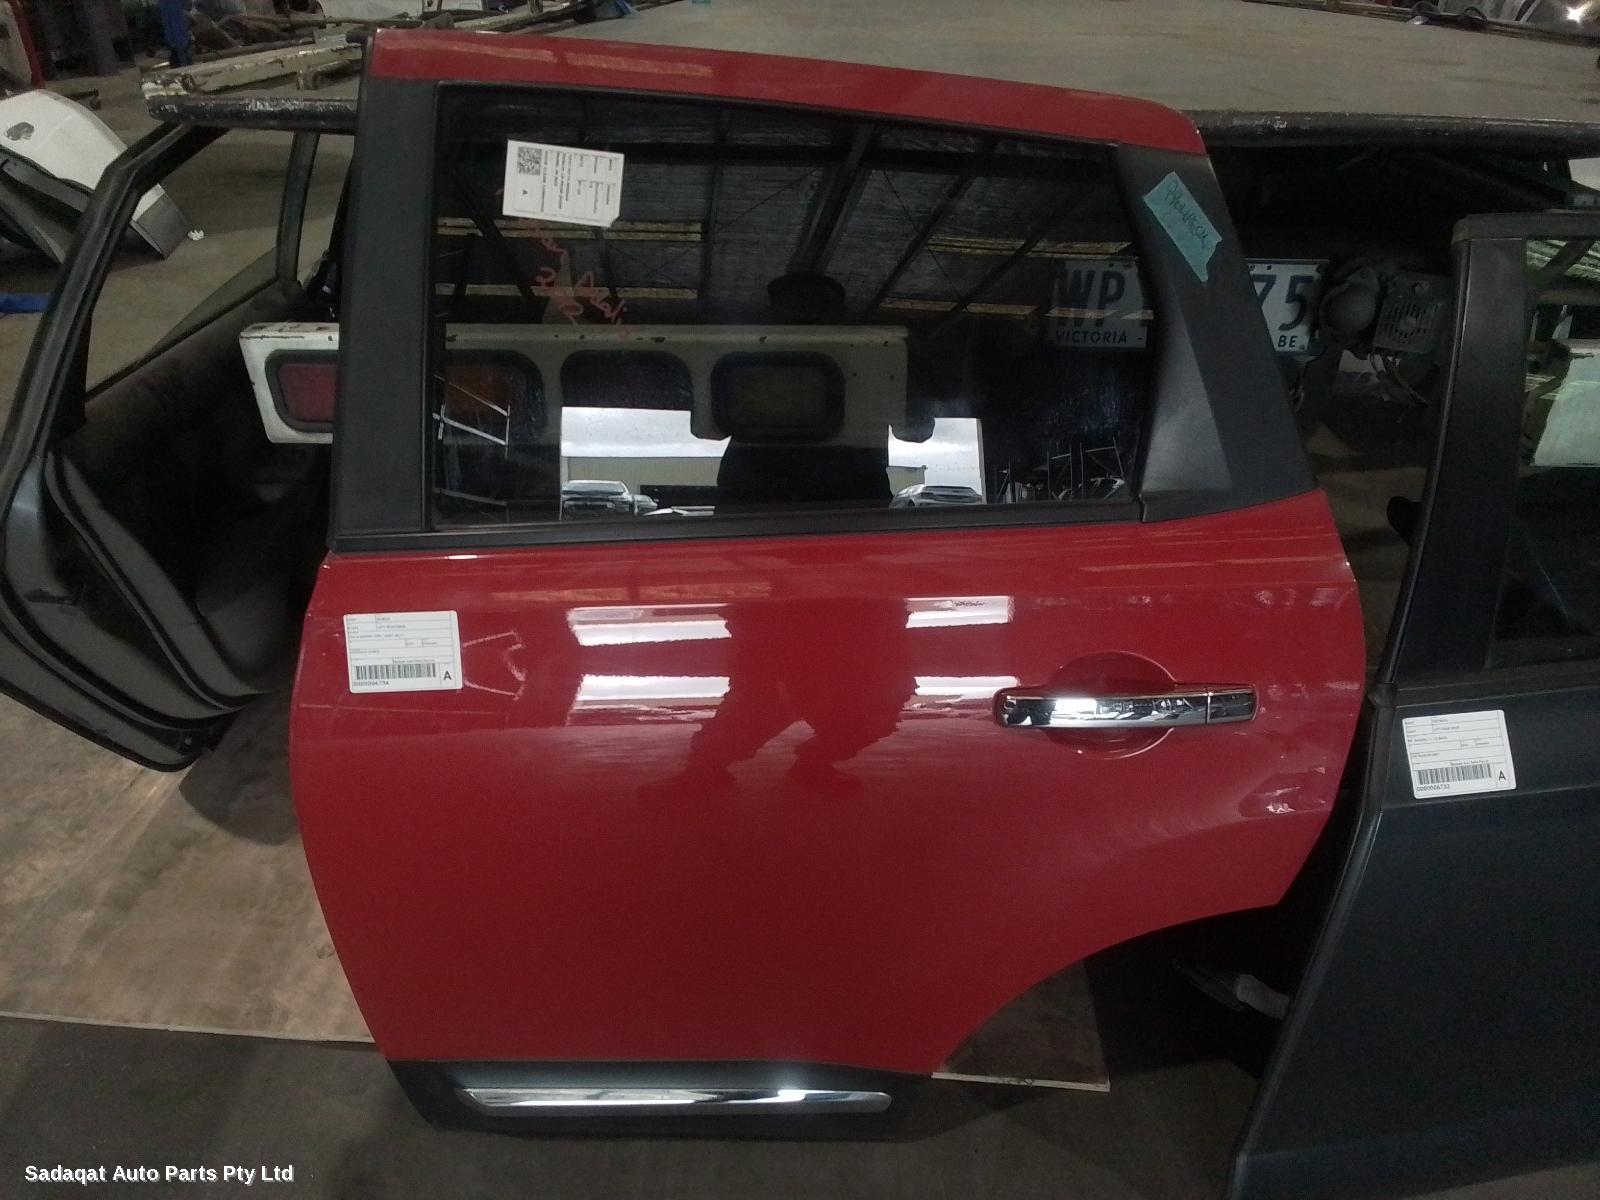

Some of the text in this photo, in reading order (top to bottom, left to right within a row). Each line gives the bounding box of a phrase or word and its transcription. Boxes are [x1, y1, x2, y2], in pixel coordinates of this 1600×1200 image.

[1055, 270, 1313, 330] WP 75
[1055, 330, 1128, 345] VICTORIA
[1277, 335, 1298, 348] BE
[443, 670, 452, 680] A
[1498, 770, 1506, 781] A
